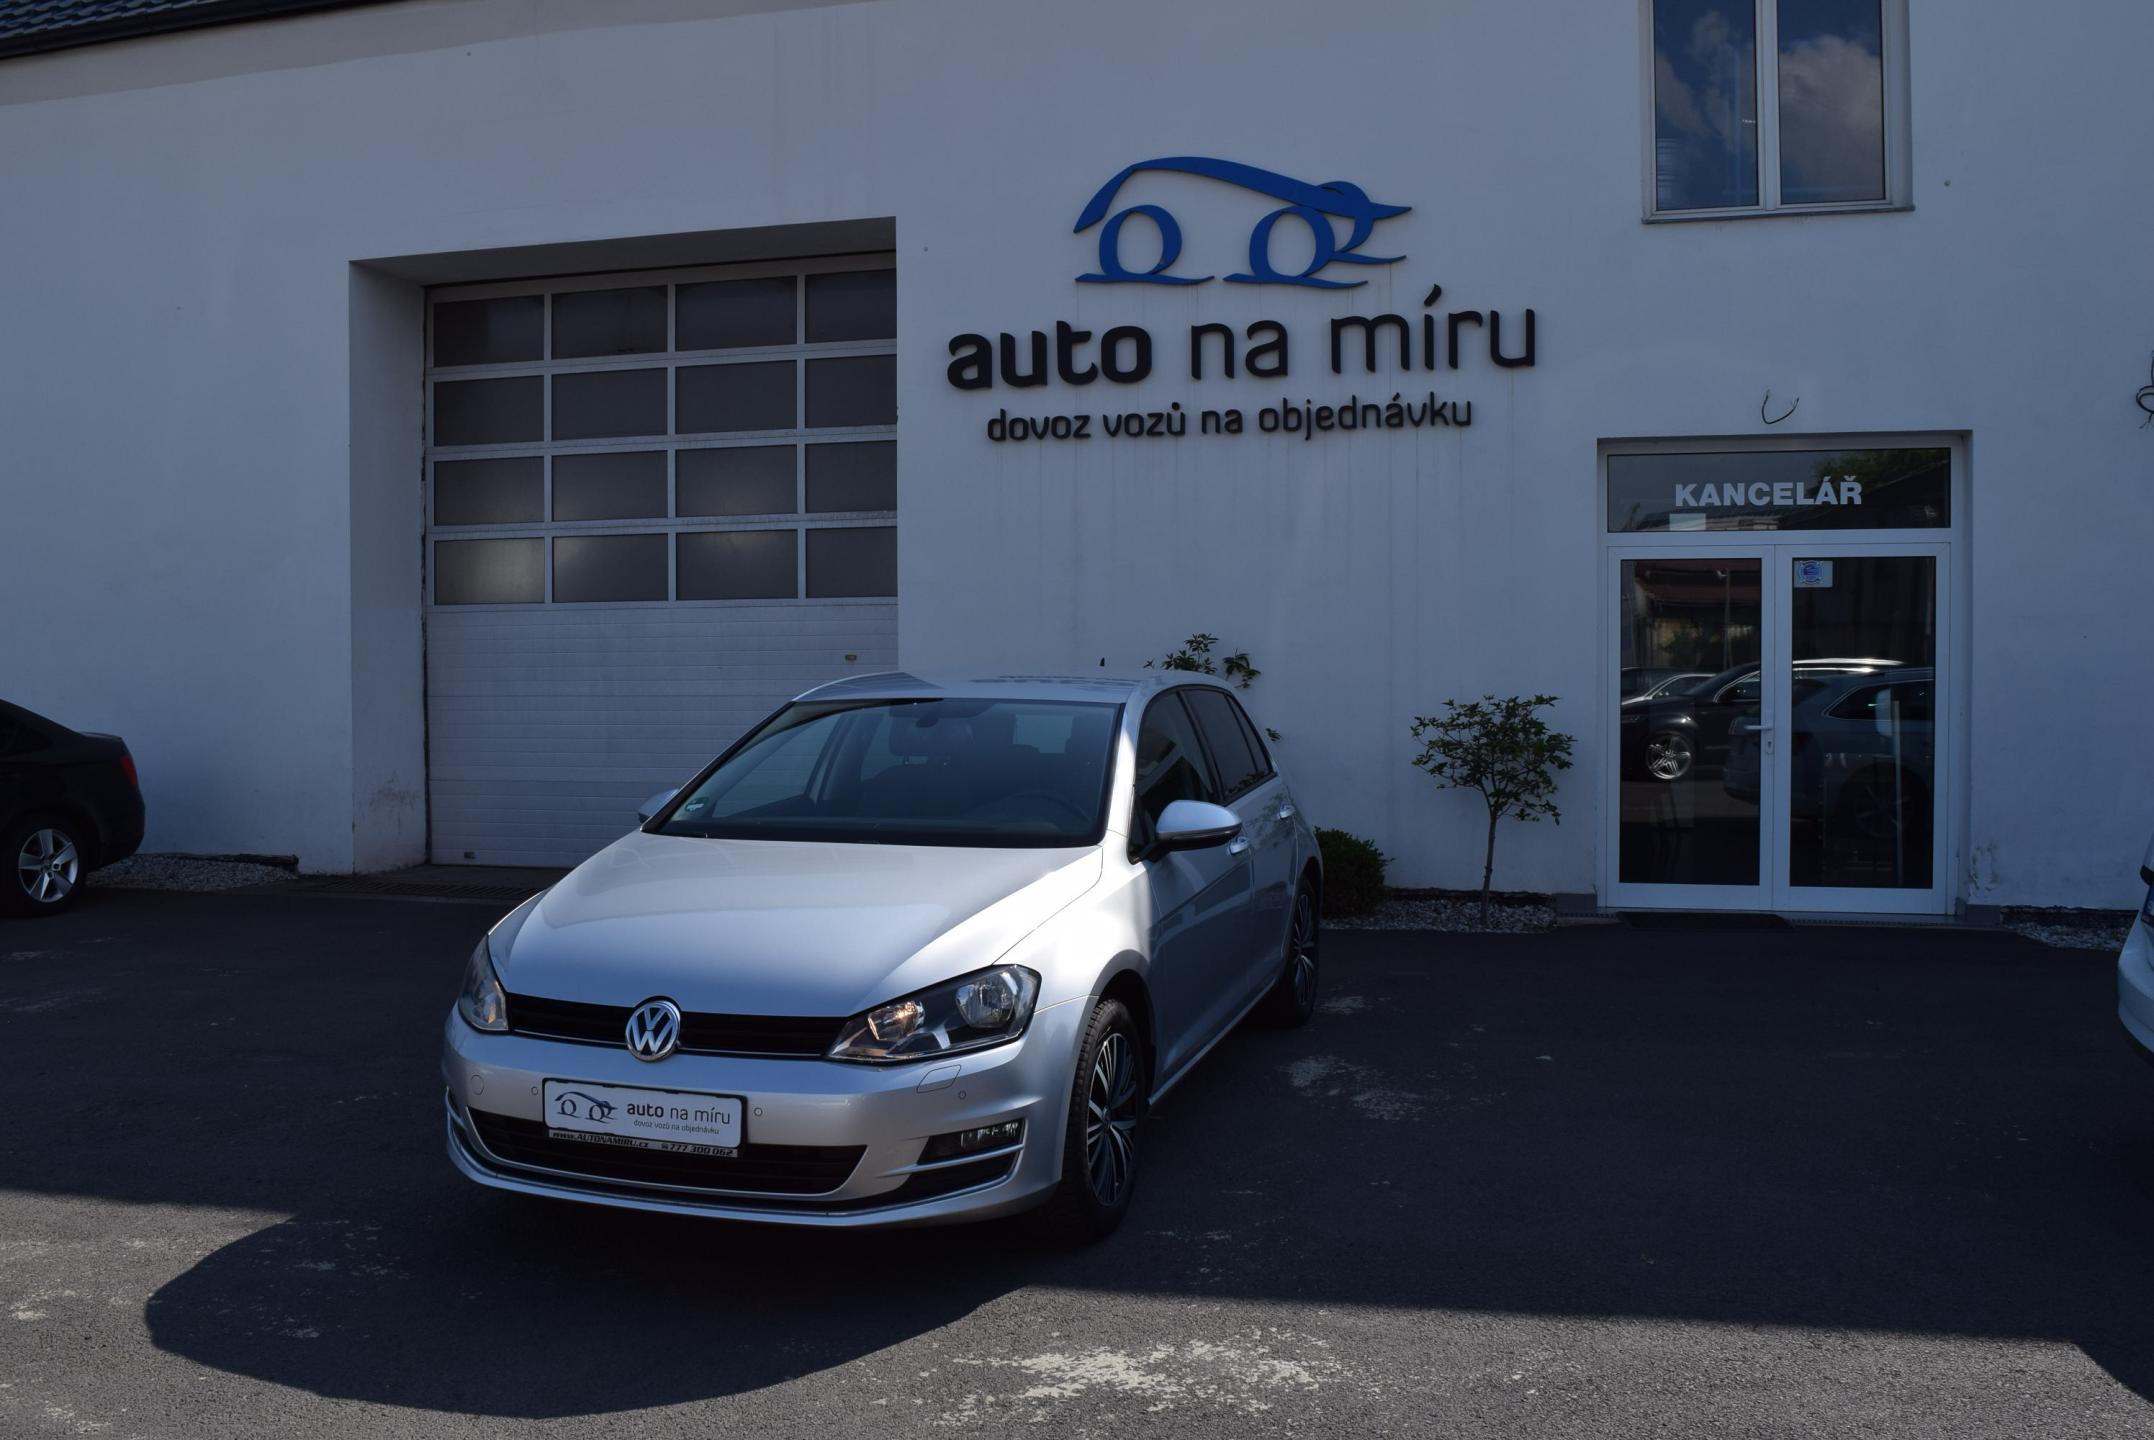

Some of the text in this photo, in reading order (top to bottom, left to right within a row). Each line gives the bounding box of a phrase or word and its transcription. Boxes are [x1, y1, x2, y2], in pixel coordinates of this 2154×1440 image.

[946, 283, 1536, 390] auto na míru
[987, 391, 1472, 442] dovoz vozů na objednávku
[1674, 475, 1863, 507] KANCELÁŘ
[626, 1102, 731, 1125] auto na míru
[633, 1119, 653, 1128] dovoz
